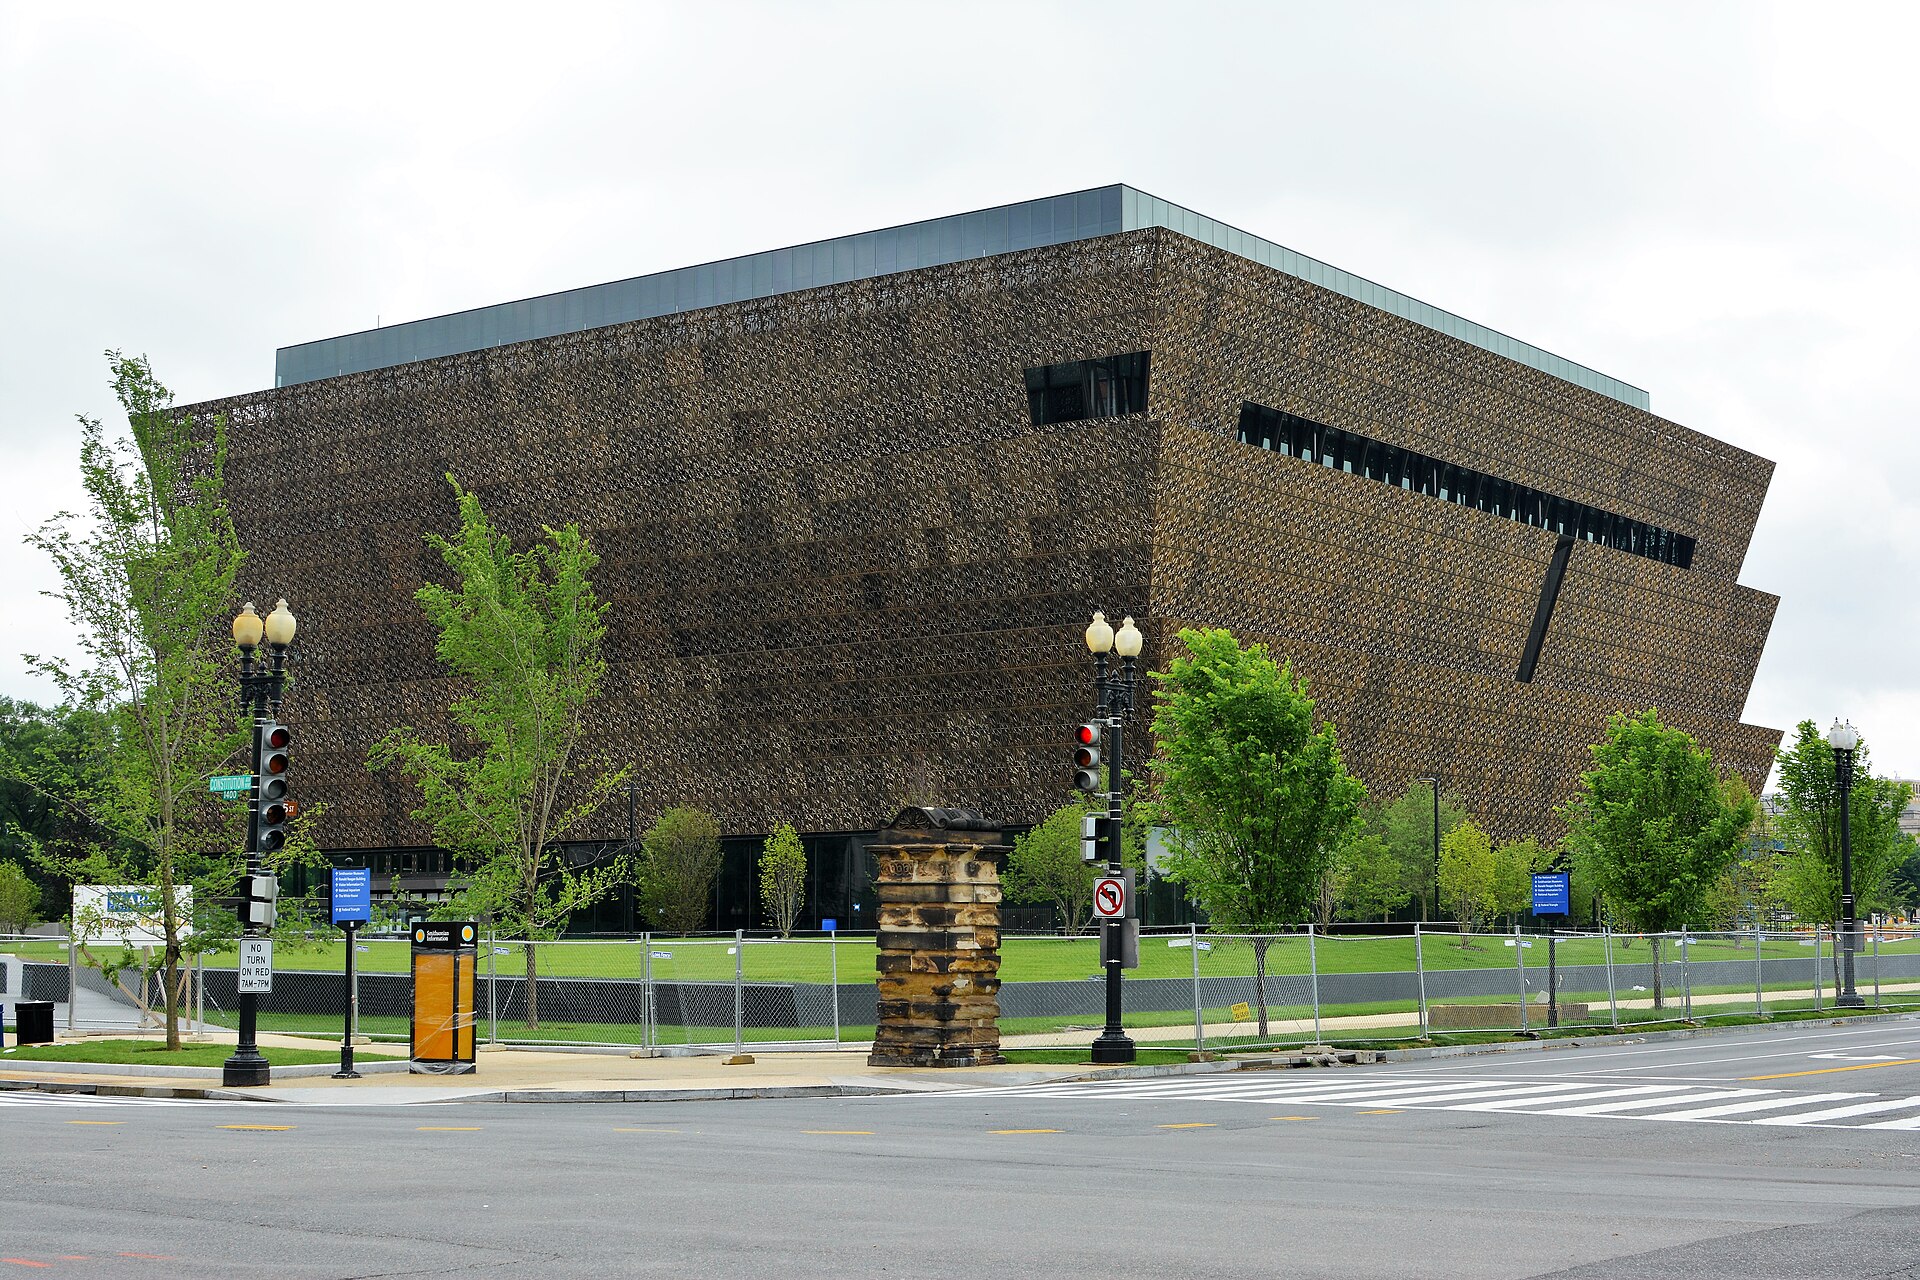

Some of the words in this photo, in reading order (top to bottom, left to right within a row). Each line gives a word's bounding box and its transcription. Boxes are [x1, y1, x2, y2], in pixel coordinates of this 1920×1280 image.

[210, 777, 245, 791] CONSTITUTION
[223, 790, 237, 799] 1400
[250, 944, 262, 952] NO
[247, 956, 266, 964] TURN
[242, 968, 252, 976] ON
[256, 968, 270, 976] RED
